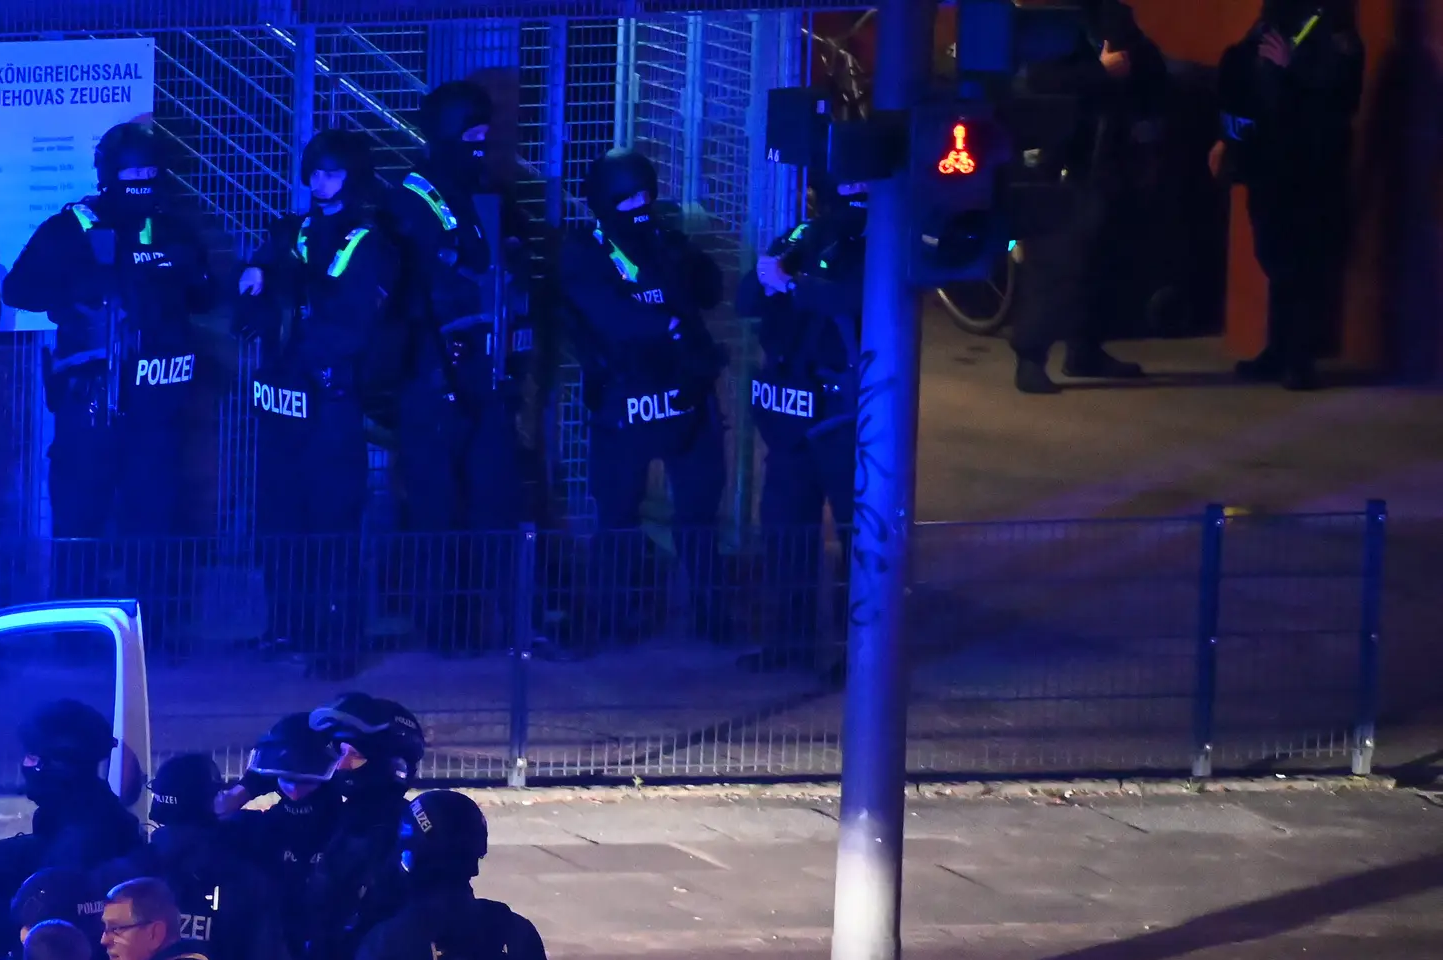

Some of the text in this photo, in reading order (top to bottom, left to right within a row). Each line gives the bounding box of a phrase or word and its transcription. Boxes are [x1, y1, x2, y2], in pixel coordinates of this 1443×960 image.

[70, 86, 132, 105] ZEUGEN
[136, 354, 195, 386] POLIZEI
[253, 380, 307, 418] POLIZEI
[751, 379, 814, 417] POLIZEI
